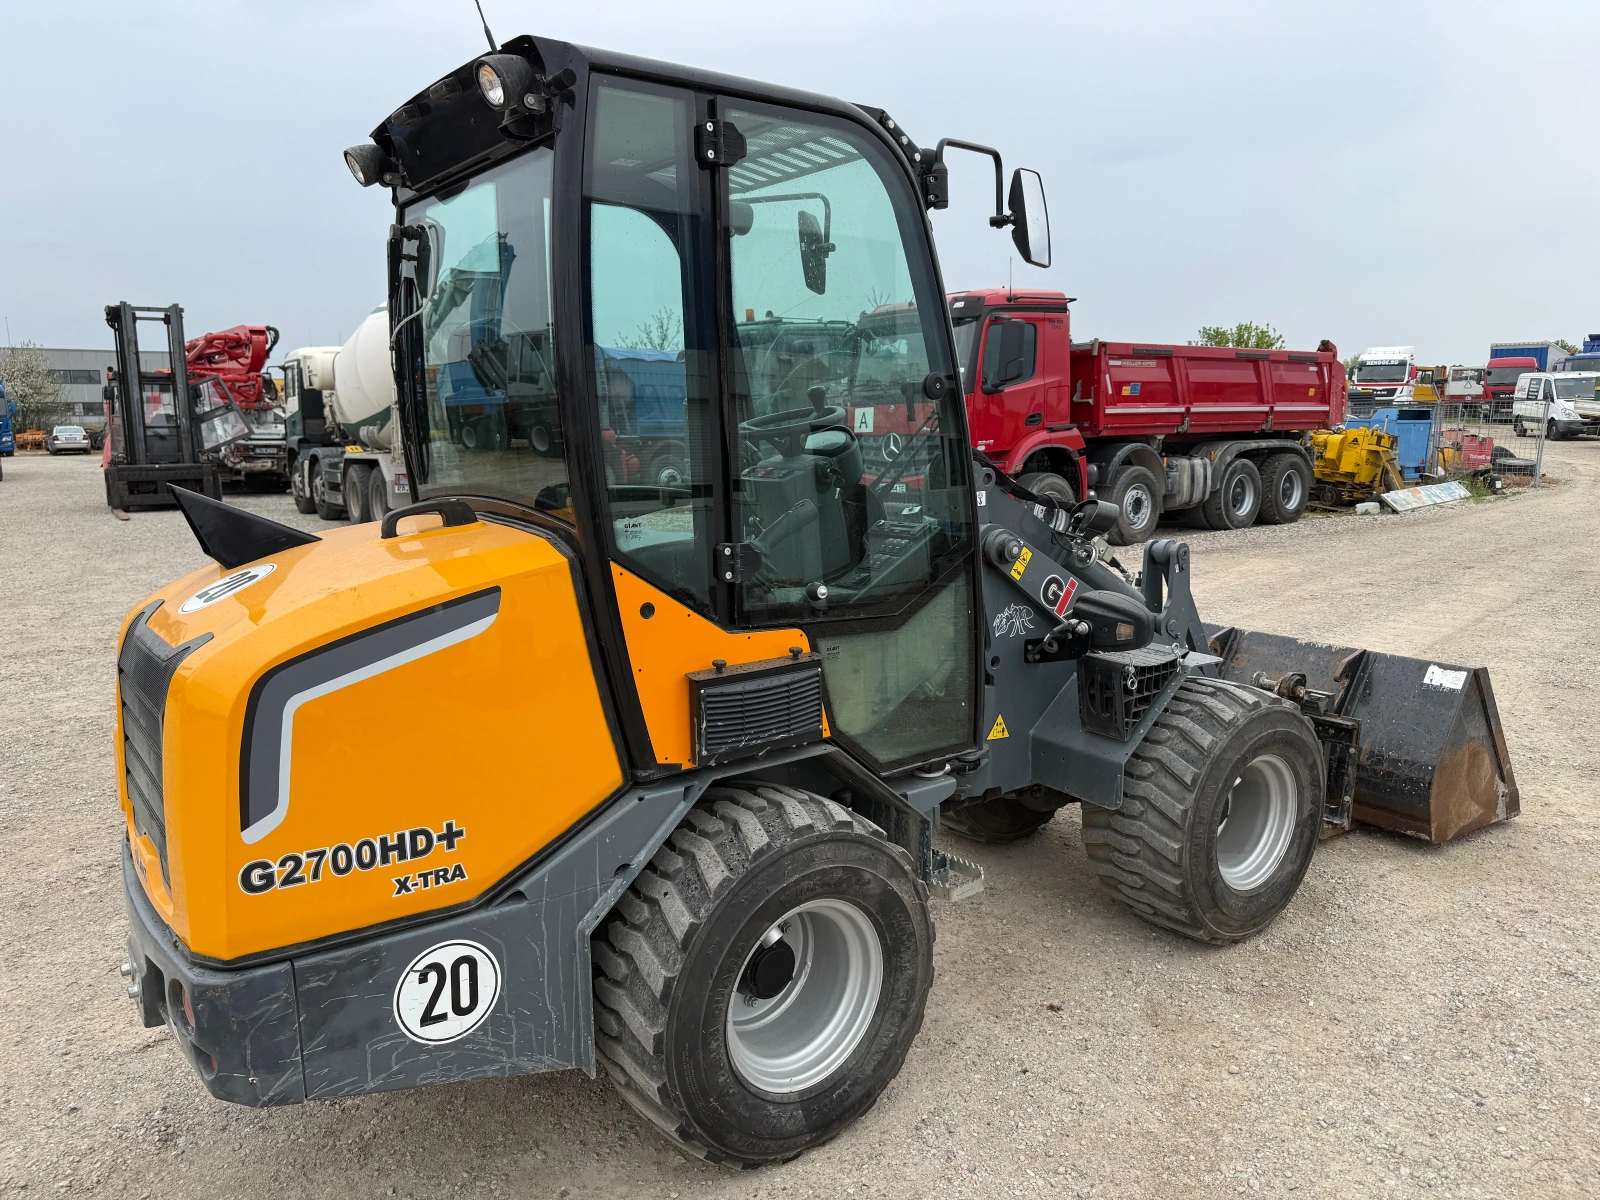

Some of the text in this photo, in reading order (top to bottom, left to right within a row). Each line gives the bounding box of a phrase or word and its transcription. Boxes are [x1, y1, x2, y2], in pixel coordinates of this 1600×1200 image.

[859, 412, 868, 429] A
[195, 571, 260, 604] 20
[239, 819, 466, 896] G2700HD+
[392, 863, 469, 898] X-TRA
[418, 954, 479, 1029] 20
